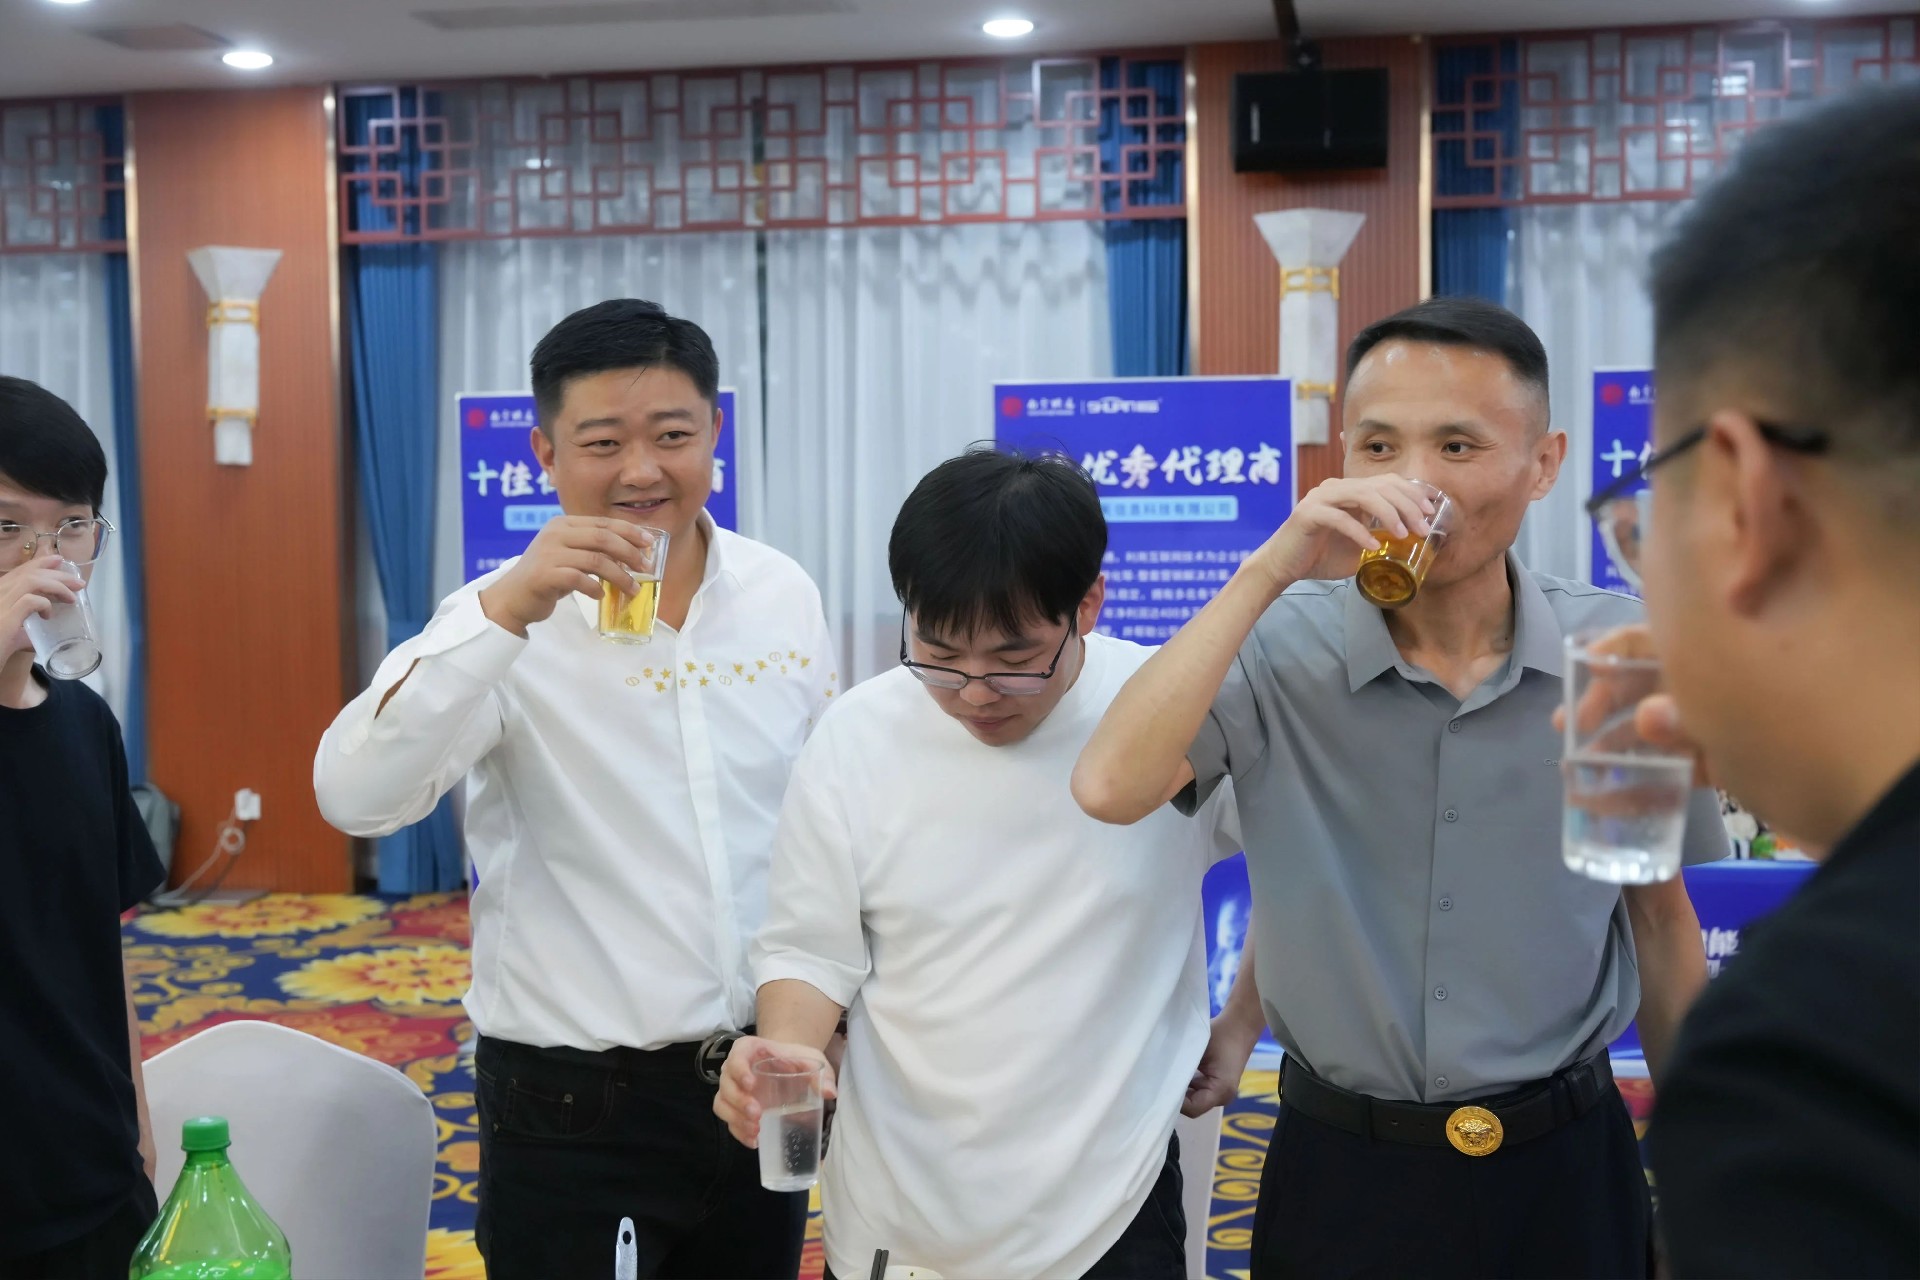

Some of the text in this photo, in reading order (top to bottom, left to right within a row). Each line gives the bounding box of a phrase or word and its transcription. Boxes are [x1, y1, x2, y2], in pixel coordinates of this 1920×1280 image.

[1080, 442, 1282, 489] 优秀代理商
